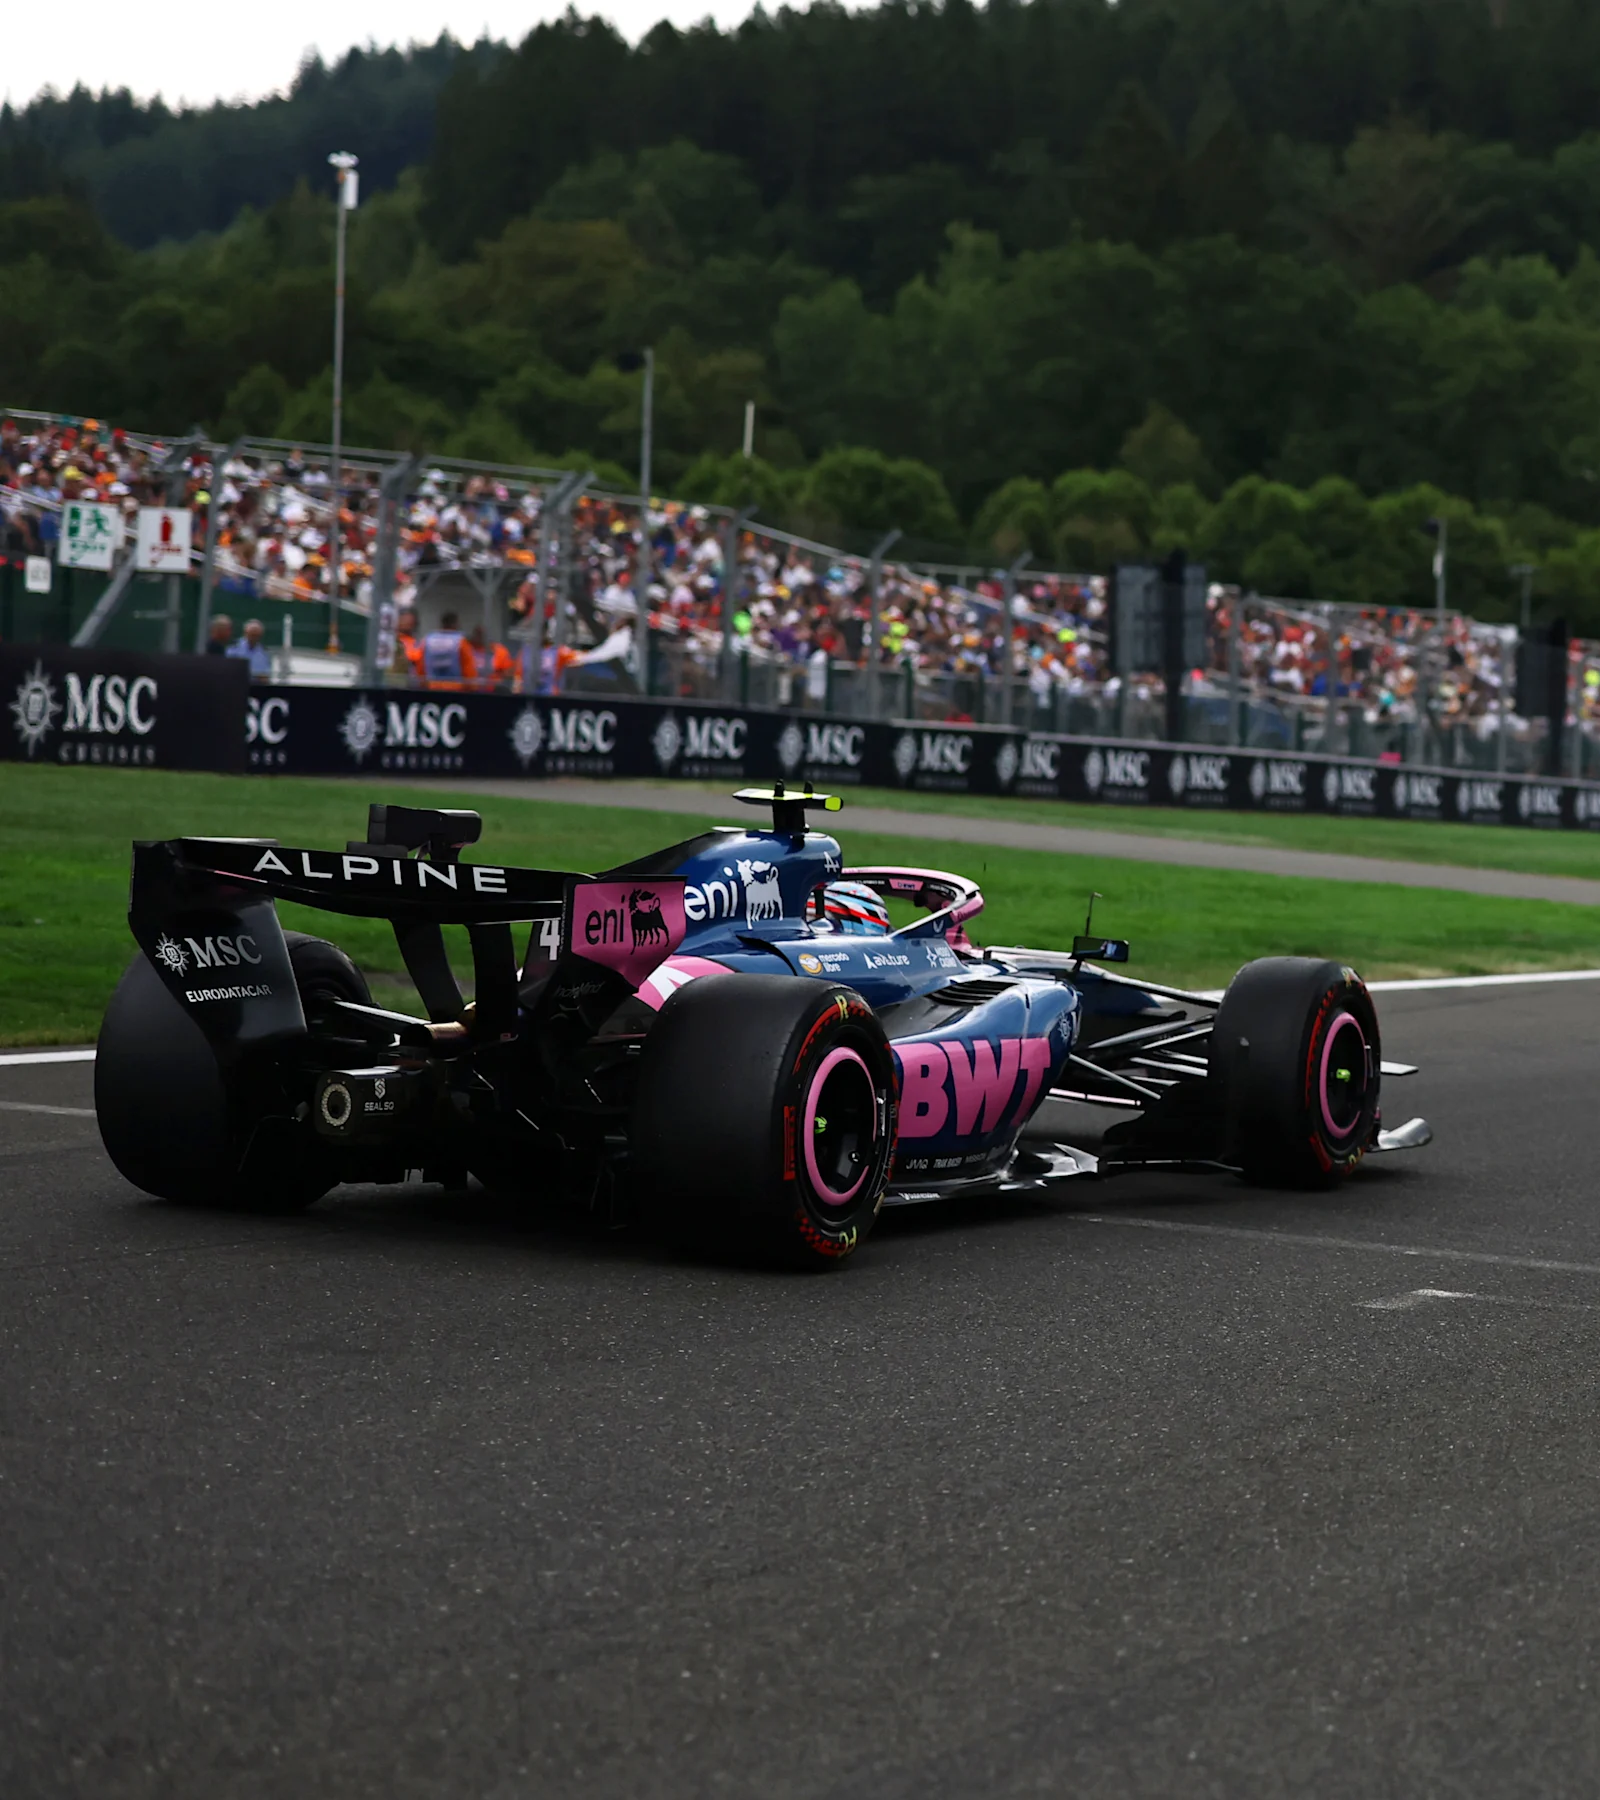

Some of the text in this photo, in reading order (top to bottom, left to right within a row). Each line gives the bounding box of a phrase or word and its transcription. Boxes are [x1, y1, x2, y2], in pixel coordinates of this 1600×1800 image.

[62, 672, 158, 735] MSC
[245, 697, 290, 744] SC
[385, 702, 467, 748] MSC
[548, 707, 617, 753] MSC
[684, 715, 748, 760] MSC
[805, 723, 865, 766] MSC
[58, 742, 157, 765] CRUISES
[918, 731, 973, 774] MSC
[253, 849, 508, 893] ALPINE
[684, 866, 739, 922] eni
[540, 919, 561, 960] 4
[585, 894, 627, 946] eni
[184, 935, 263, 969] MSC
[818, 951, 850, 963] mercado
[823, 962, 842, 973] libre
[185, 984, 273, 1003] EURODATACAR
[892, 1037, 1052, 1139] BWT
